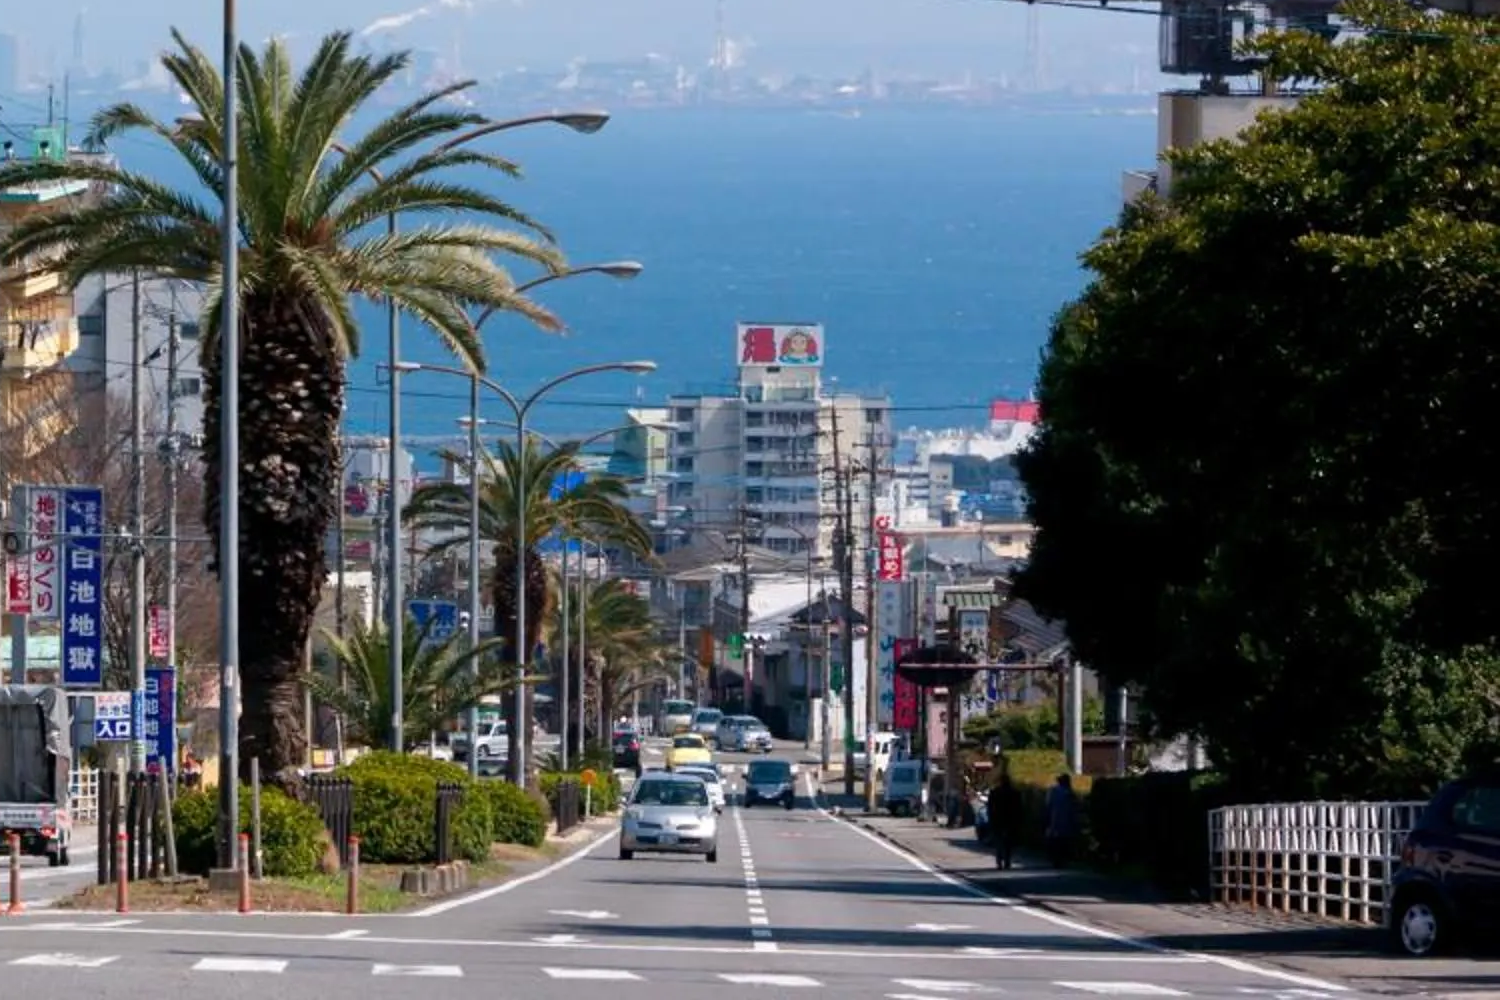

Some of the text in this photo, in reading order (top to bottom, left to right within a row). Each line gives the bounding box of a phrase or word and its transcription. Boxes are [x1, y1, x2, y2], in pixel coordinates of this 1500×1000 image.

[69, 549, 96, 671] 白池地獄
[98, 720, 131, 737] 入口
